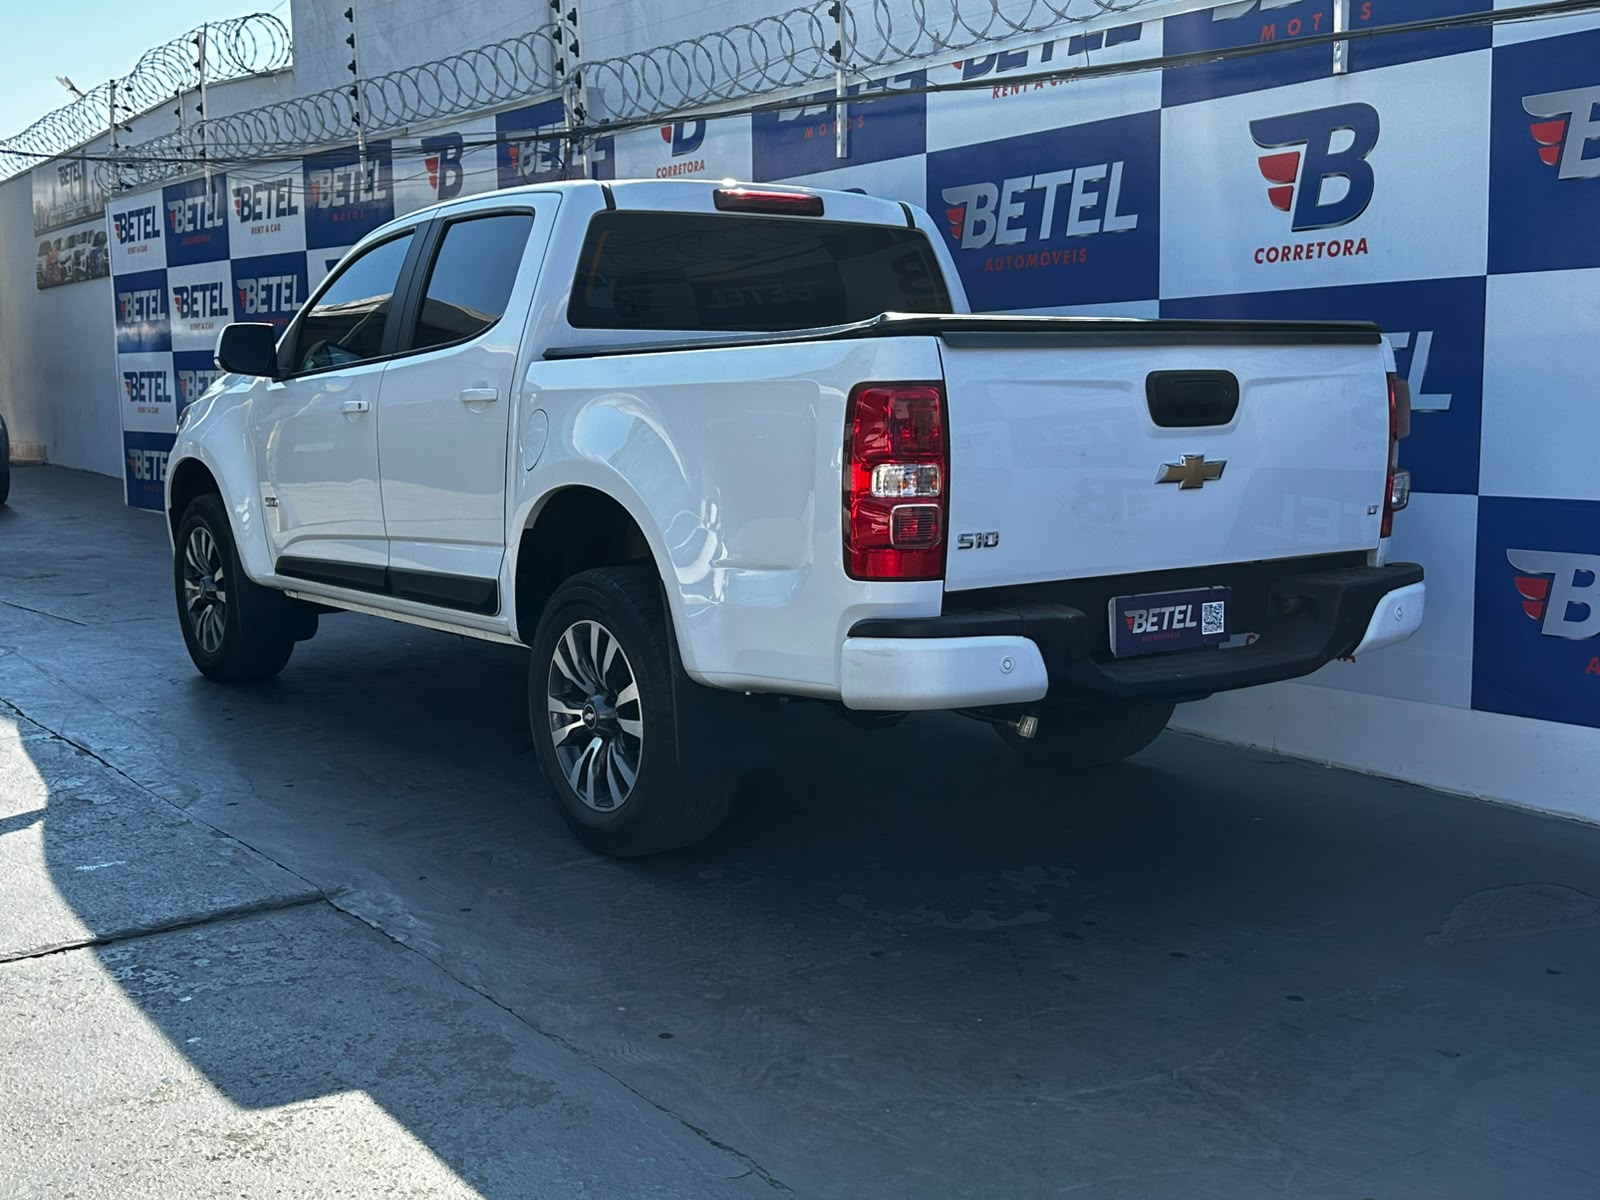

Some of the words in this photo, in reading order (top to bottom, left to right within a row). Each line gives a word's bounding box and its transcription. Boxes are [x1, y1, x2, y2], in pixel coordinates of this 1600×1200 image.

[656, 159, 705, 179] CORRETORA
[231, 177, 299, 223] BETEL
[941, 160, 1139, 250] BETEL
[113, 205, 160, 245] BETEL
[1253, 237, 1369, 264] CORRETORA
[118, 288, 166, 323] BETEL
[172, 282, 228, 319] BETEL
[237, 274, 303, 314] BETEL
[123, 371, 171, 402] BETEL
[957, 531, 1000, 550] S10
[1124, 604, 1197, 634] BETEL
